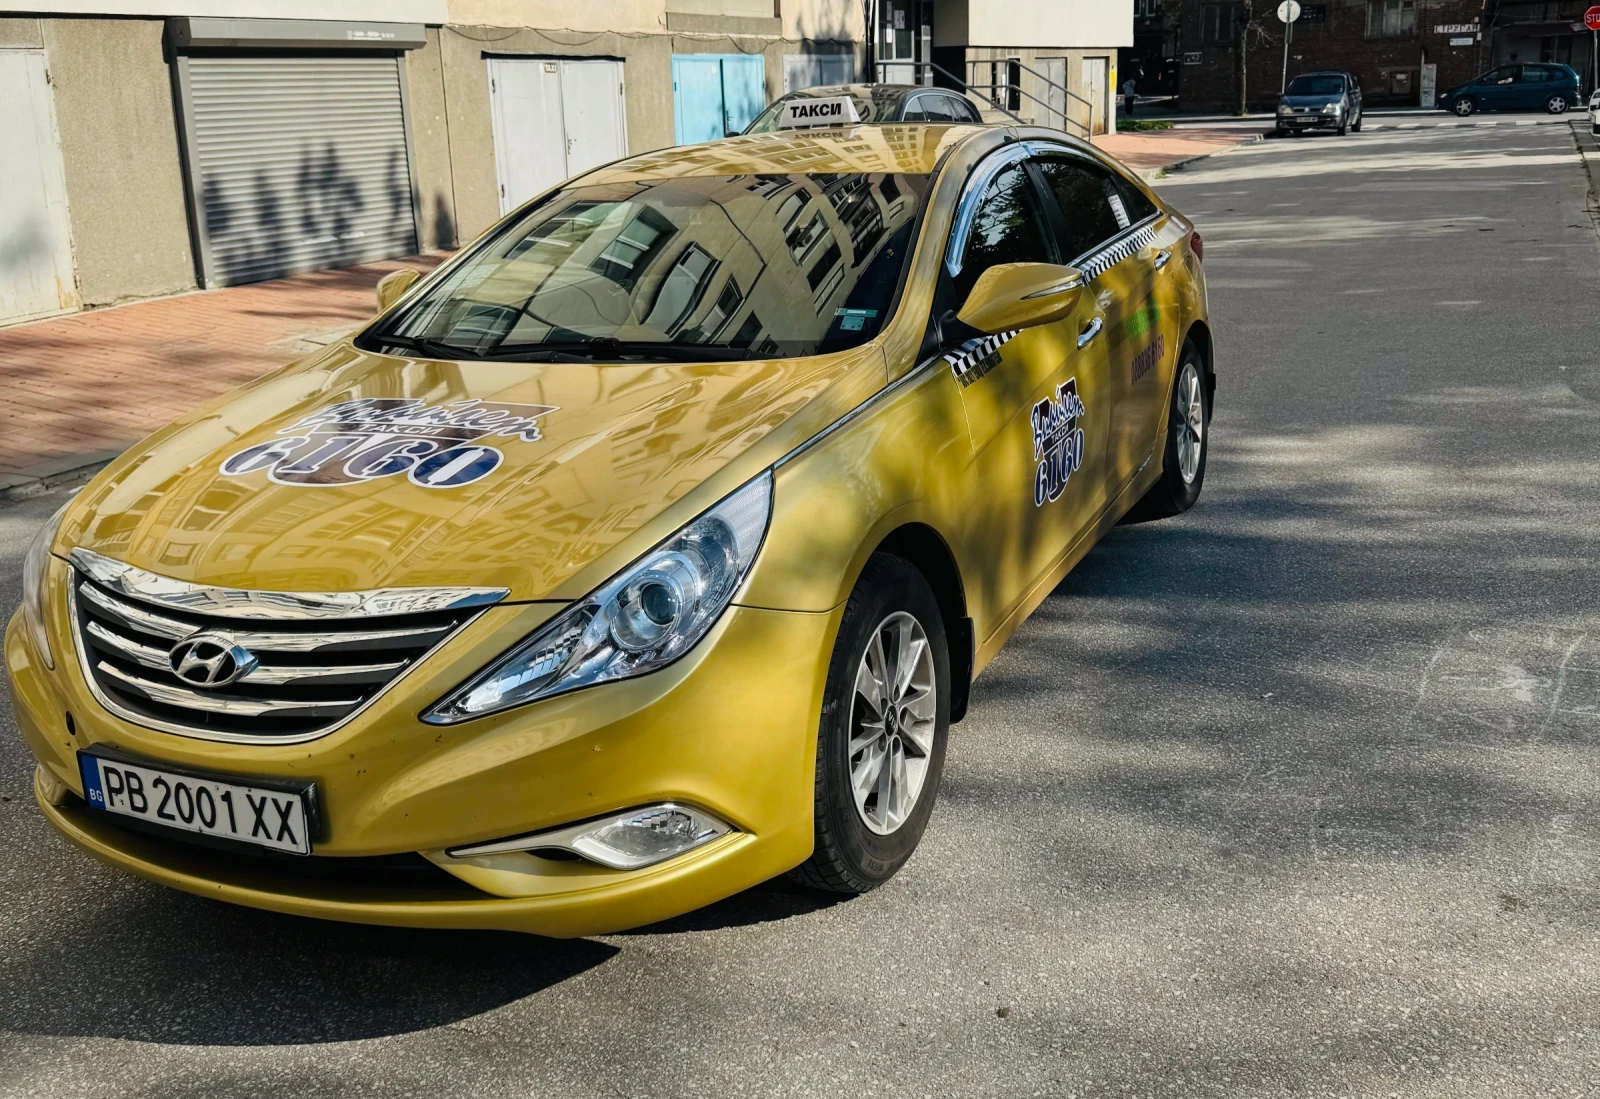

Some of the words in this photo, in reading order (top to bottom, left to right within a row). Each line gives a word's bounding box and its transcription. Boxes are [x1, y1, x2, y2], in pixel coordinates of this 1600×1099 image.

[790, 103, 842, 118] ТАКСИ
[359, 424, 441, 436] ТАКСИ
[219, 436, 505, 488] 6160
[1035, 428, 1084, 507] 6160
[89, 788, 103, 802] BG
[103, 765, 148, 814] PB
[152, 777, 237, 833] 2001
[246, 793, 298, 845] XX
